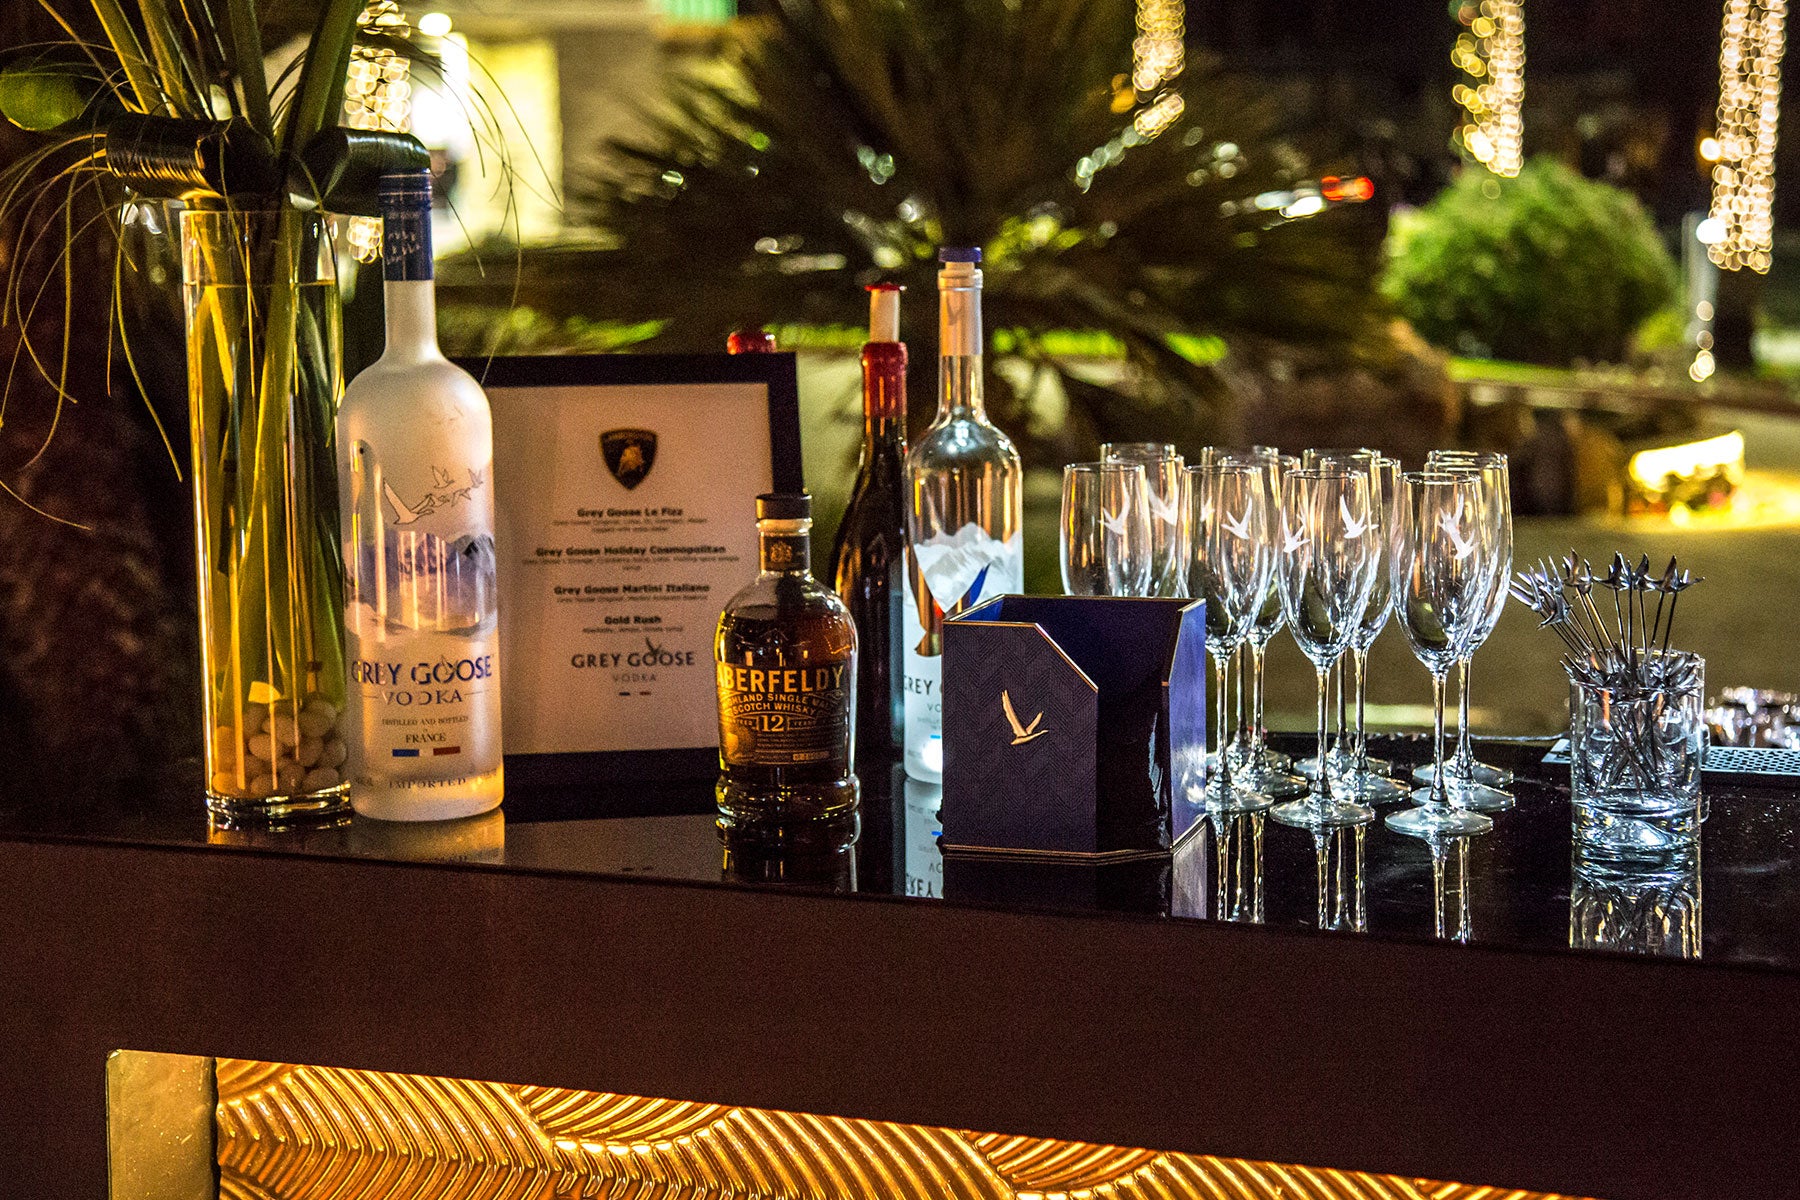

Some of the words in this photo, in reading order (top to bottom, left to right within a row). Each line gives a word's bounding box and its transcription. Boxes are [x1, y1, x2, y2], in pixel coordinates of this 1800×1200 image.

[577, 508, 604, 519] Grey
[606, 508, 641, 517] Goose
[645, 508, 657, 517] Le
[661, 508, 683, 517] Fizz
[536, 548, 562, 557] Grey
[566, 547, 601, 556] Goose
[604, 546, 647, 556] Holiday
[650, 545, 727, 556] Cosmopolitan
[554, 586, 580, 596] Grey
[584, 585, 619, 595] Goose
[622, 585, 662, 594] Martini
[666, 584, 711, 593] Italiano
[604, 616, 630, 625] Gold
[633, 616, 662, 625] Rush
[571, 653, 621, 669] GREY
[627, 651, 695, 668] GOOSE
[411, 655, 492, 685] GOOSE
[613, 673, 657, 683] VODKA
[717, 662, 844, 693] ABERFELDY
[382, 689, 463, 706] VODKA
[767, 693, 809, 705] SINGLE
[732, 702, 771, 716] SCOTCH
[774, 702, 817, 716] WHISKY
[420, 718, 436, 726] AND
[761, 714, 785, 732] 12
[405, 733, 446, 744] FRANCE
[388, 777, 467, 790] IMPORTED
